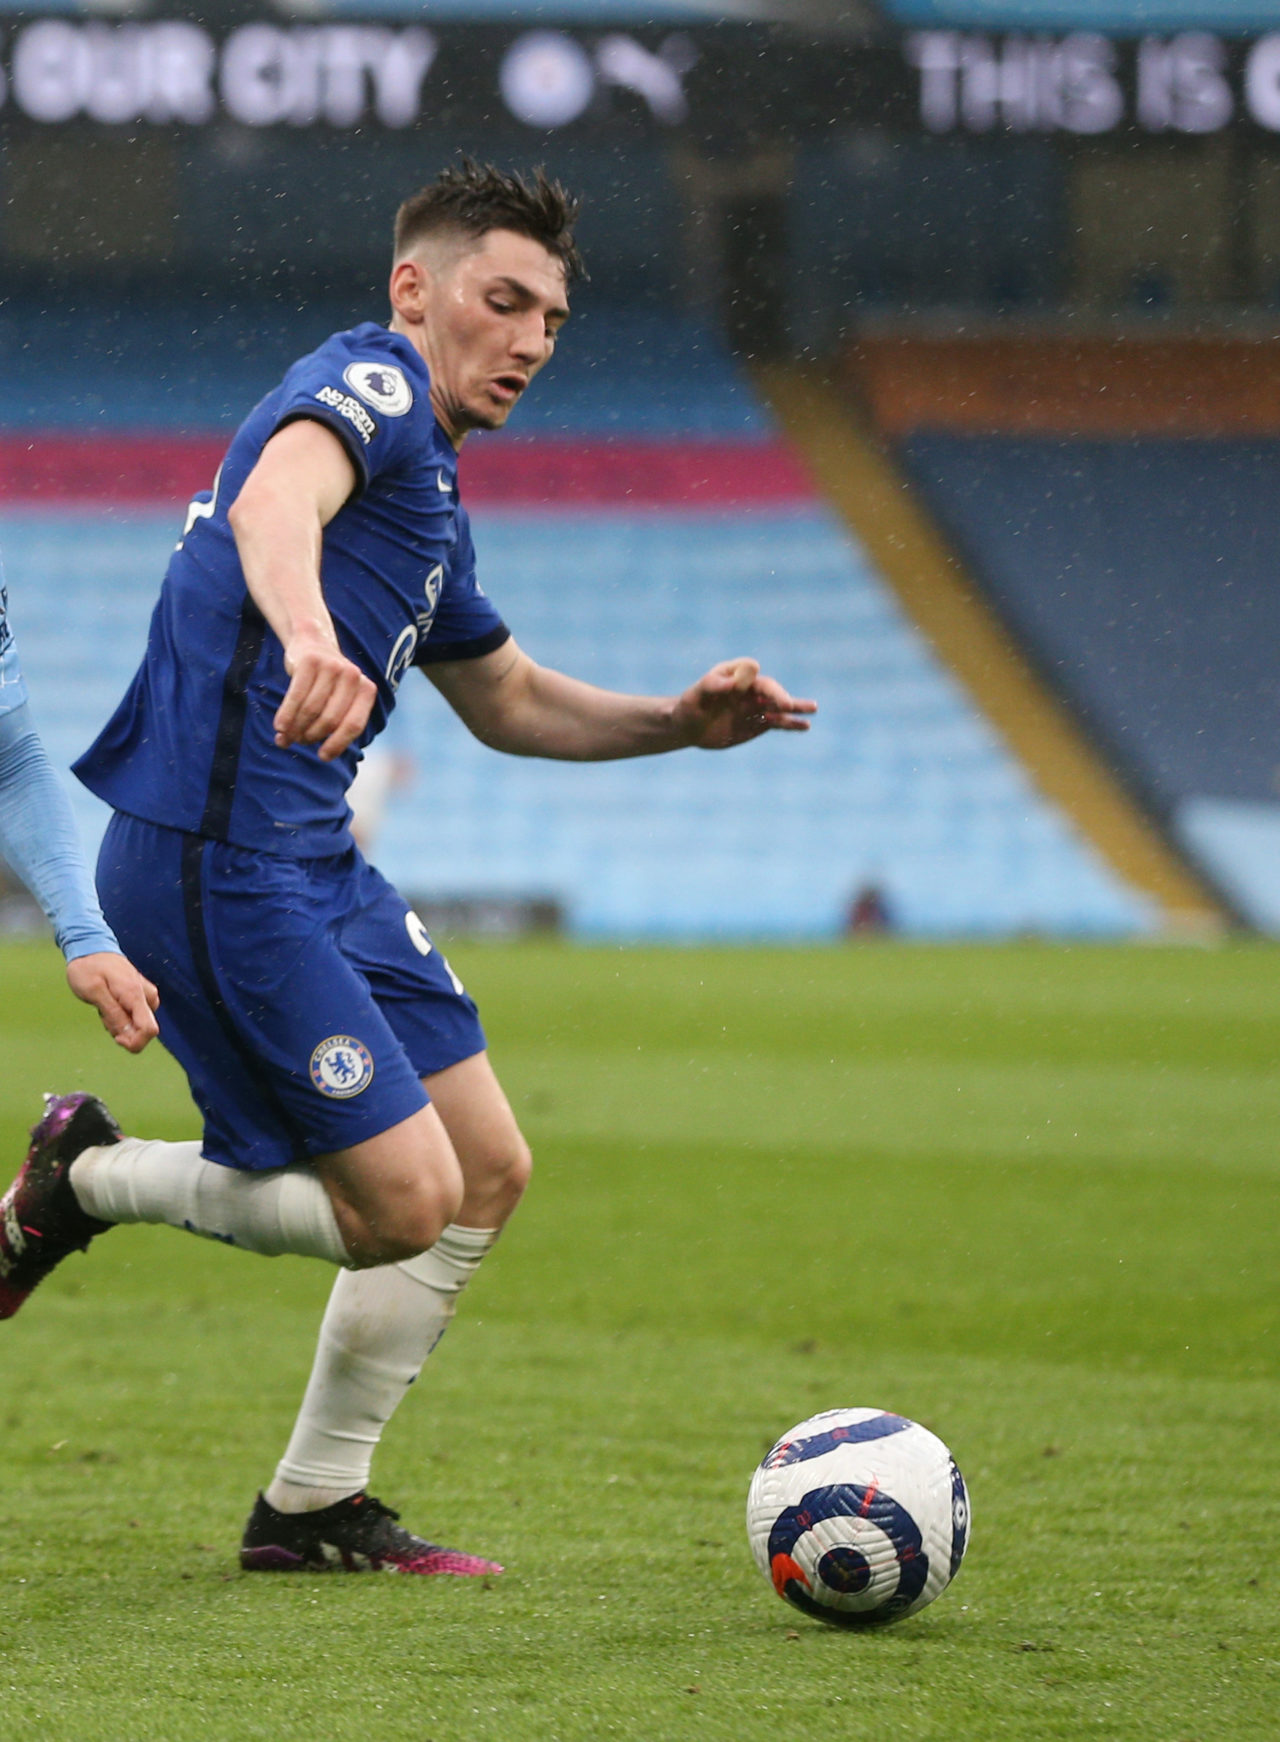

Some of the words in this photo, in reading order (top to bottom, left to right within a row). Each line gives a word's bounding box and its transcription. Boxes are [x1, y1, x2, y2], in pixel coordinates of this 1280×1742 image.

[12, 18, 216, 125] OUR
[218, 22, 436, 127] CITY
[905, 30, 1122, 134] THIS
[1135, 32, 1233, 133] IS
